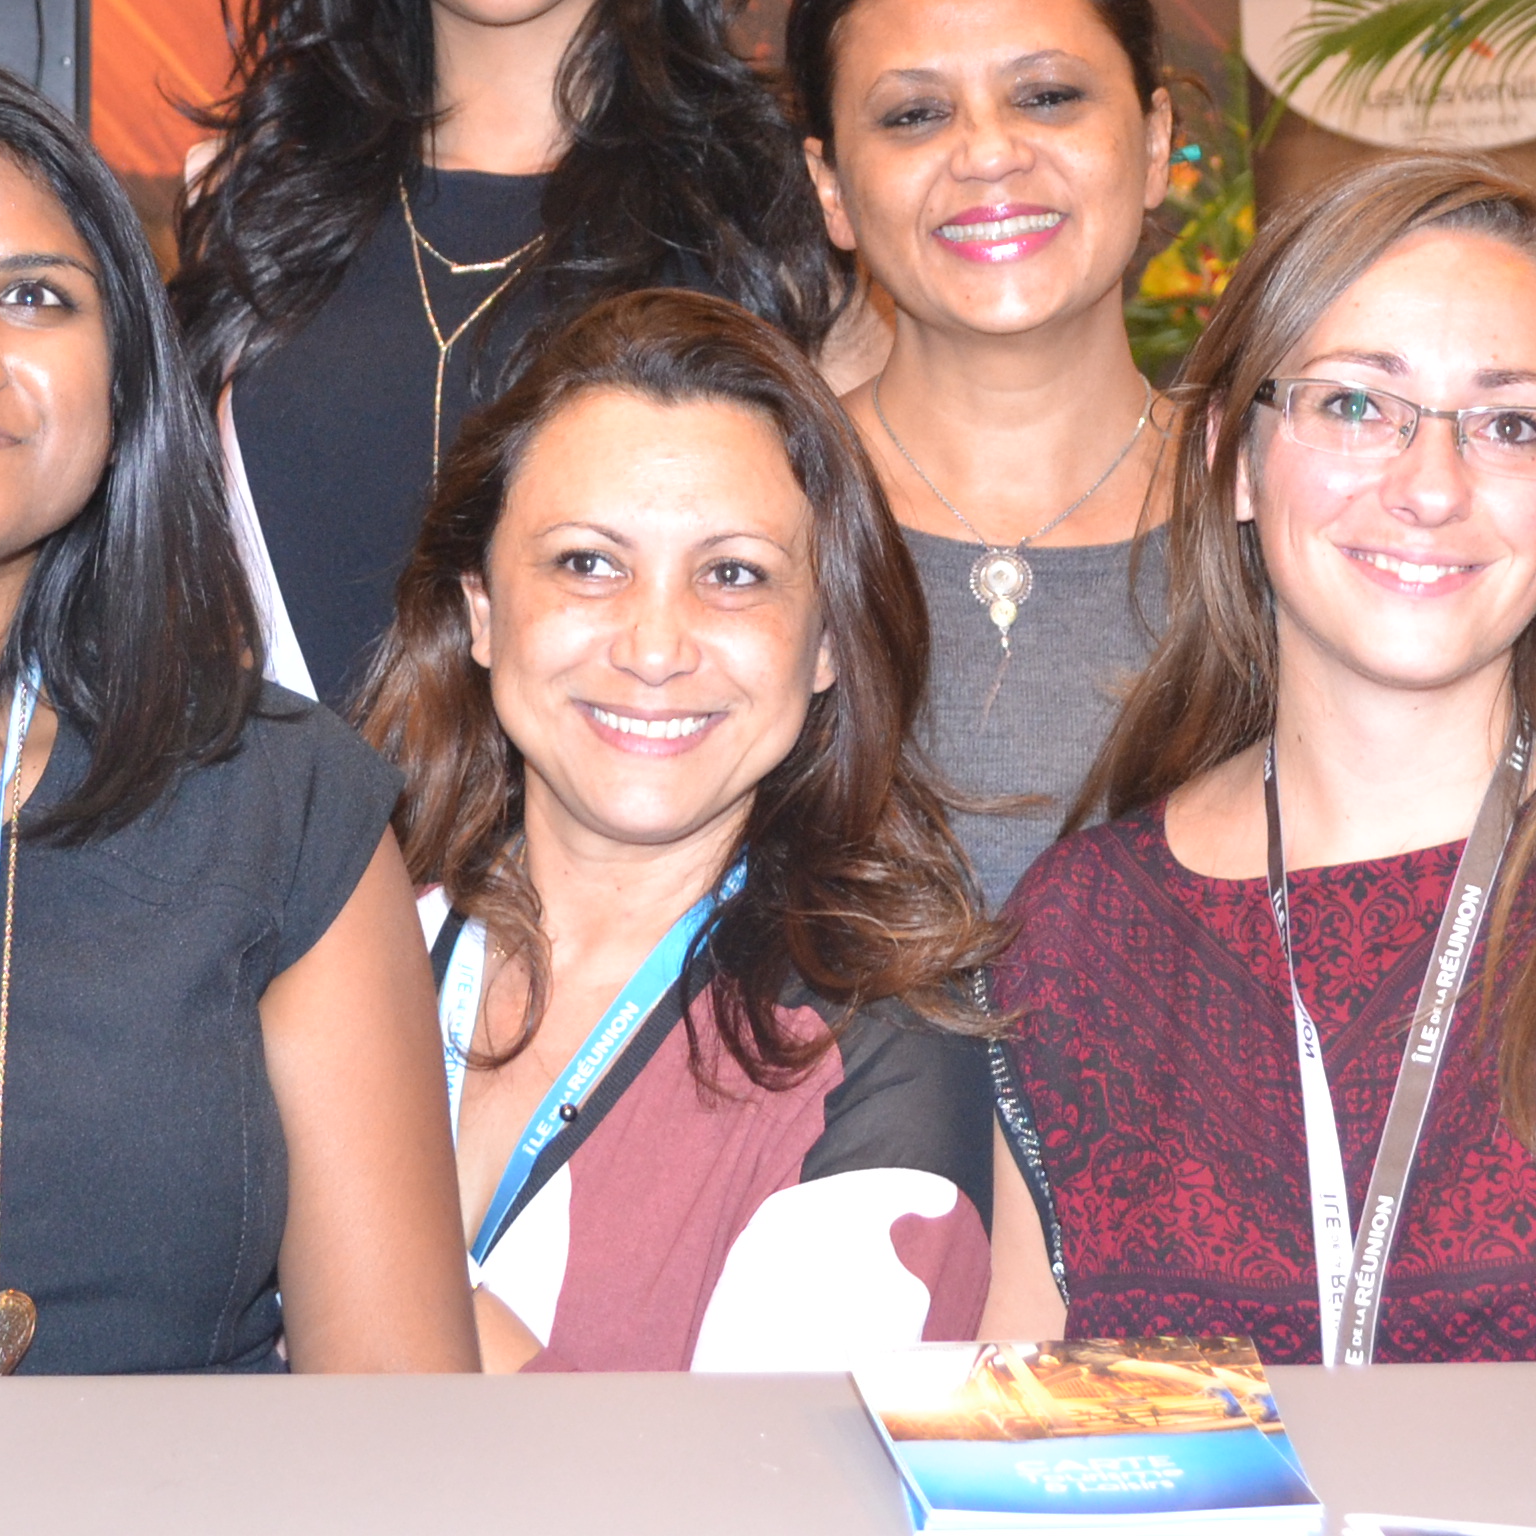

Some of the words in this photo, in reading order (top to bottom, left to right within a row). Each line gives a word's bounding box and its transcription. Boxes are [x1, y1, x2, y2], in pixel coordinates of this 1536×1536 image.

[1410, 1023, 1442, 1065] ÎLE
[1435, 883, 1483, 990] RÉUNION
[522, 1116, 554, 1158] ÎLE
[568, 1000, 642, 1094] RÉUNION
[1353, 1194, 1395, 1308] RÉUNION
